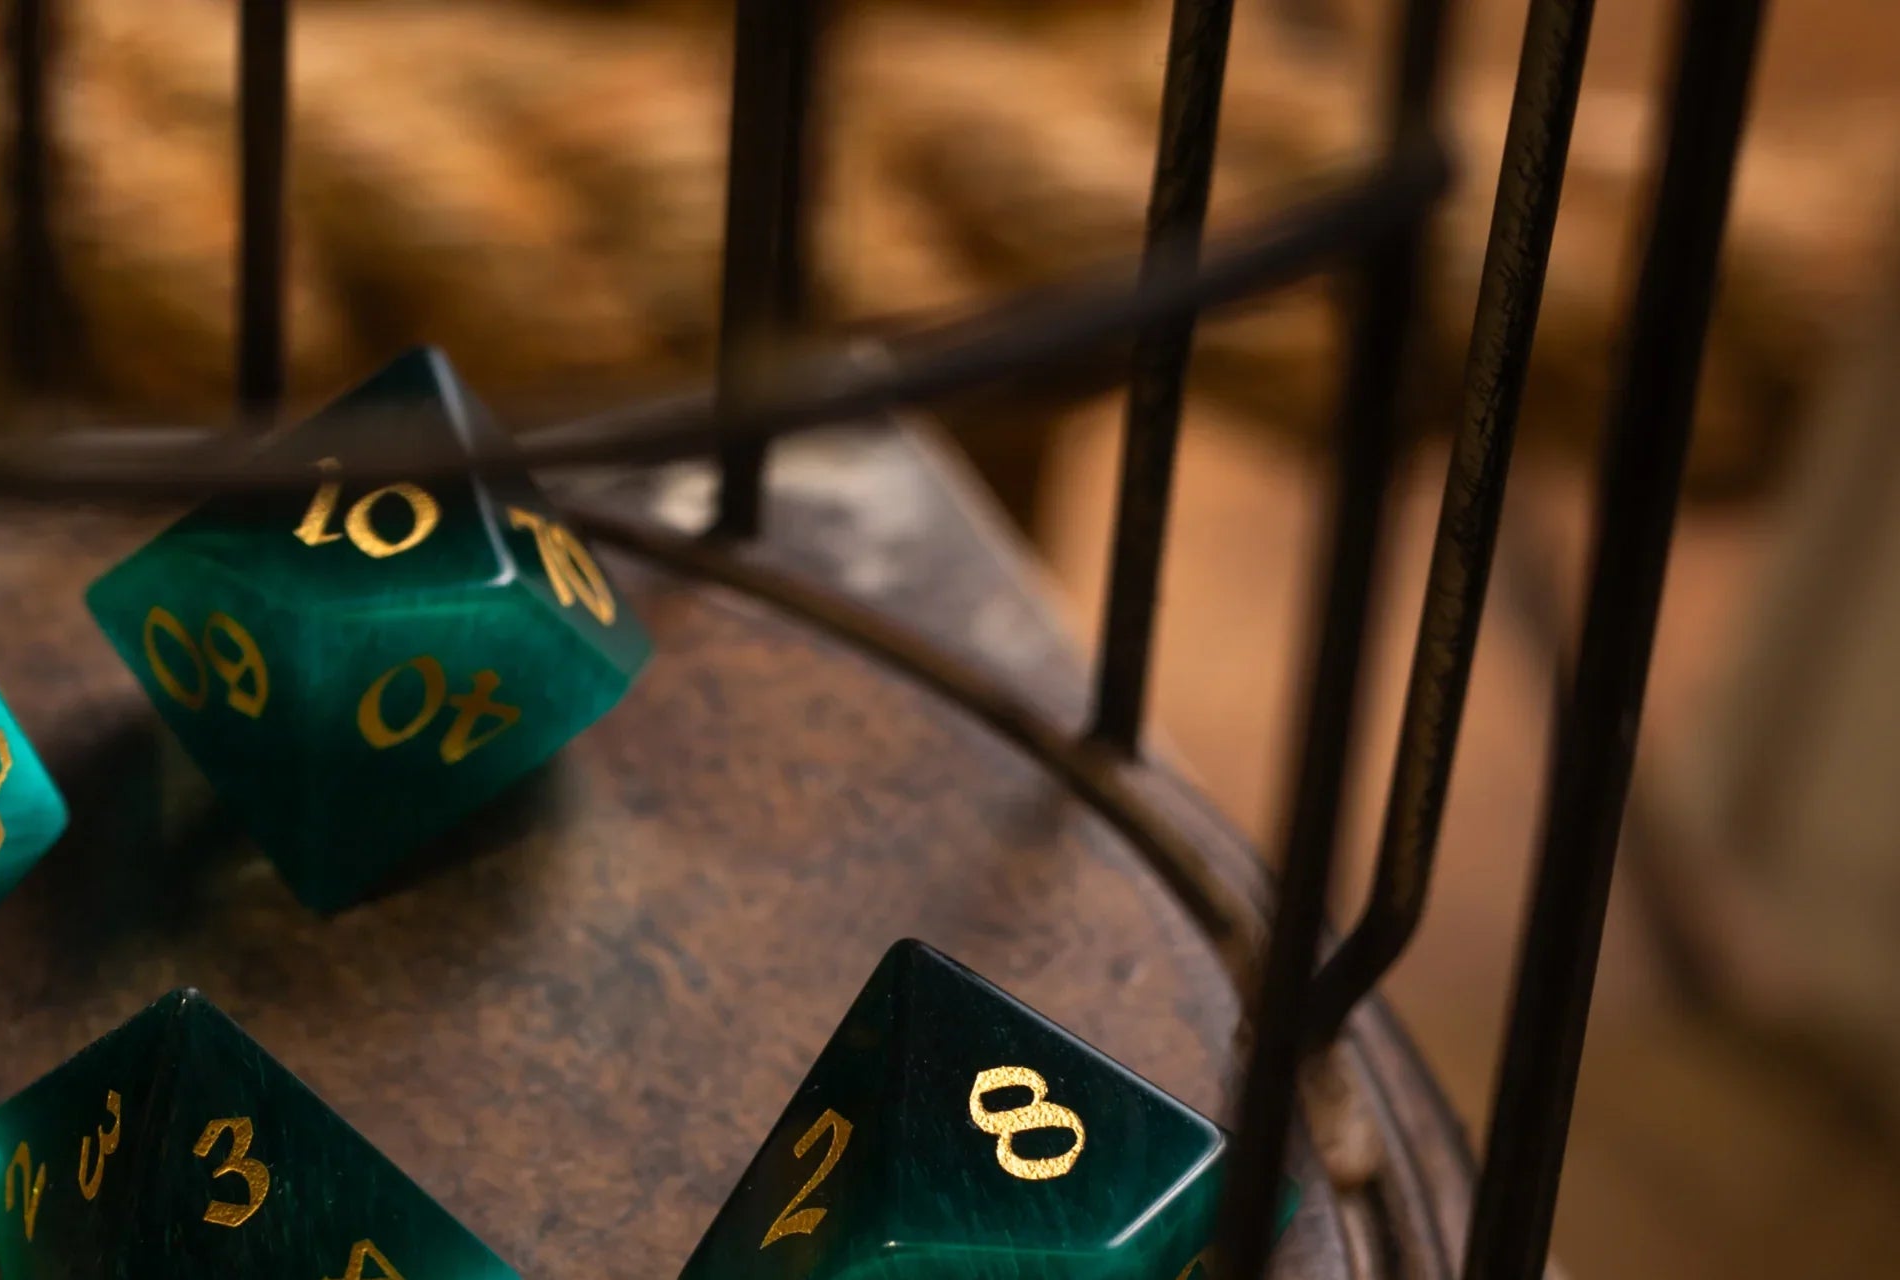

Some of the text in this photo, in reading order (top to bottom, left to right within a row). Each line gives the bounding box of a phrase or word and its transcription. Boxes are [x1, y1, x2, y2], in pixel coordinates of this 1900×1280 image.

[293, 457, 442, 559] 10
[356, 654, 521, 764] 40
[77, 1089, 122, 1201] 3
[192, 1116, 271, 1228] 3
[759, 1107, 854, 1250] 2
[968, 1065, 1087, 1181] 8
[5, 1140, 46, 1242] 2
